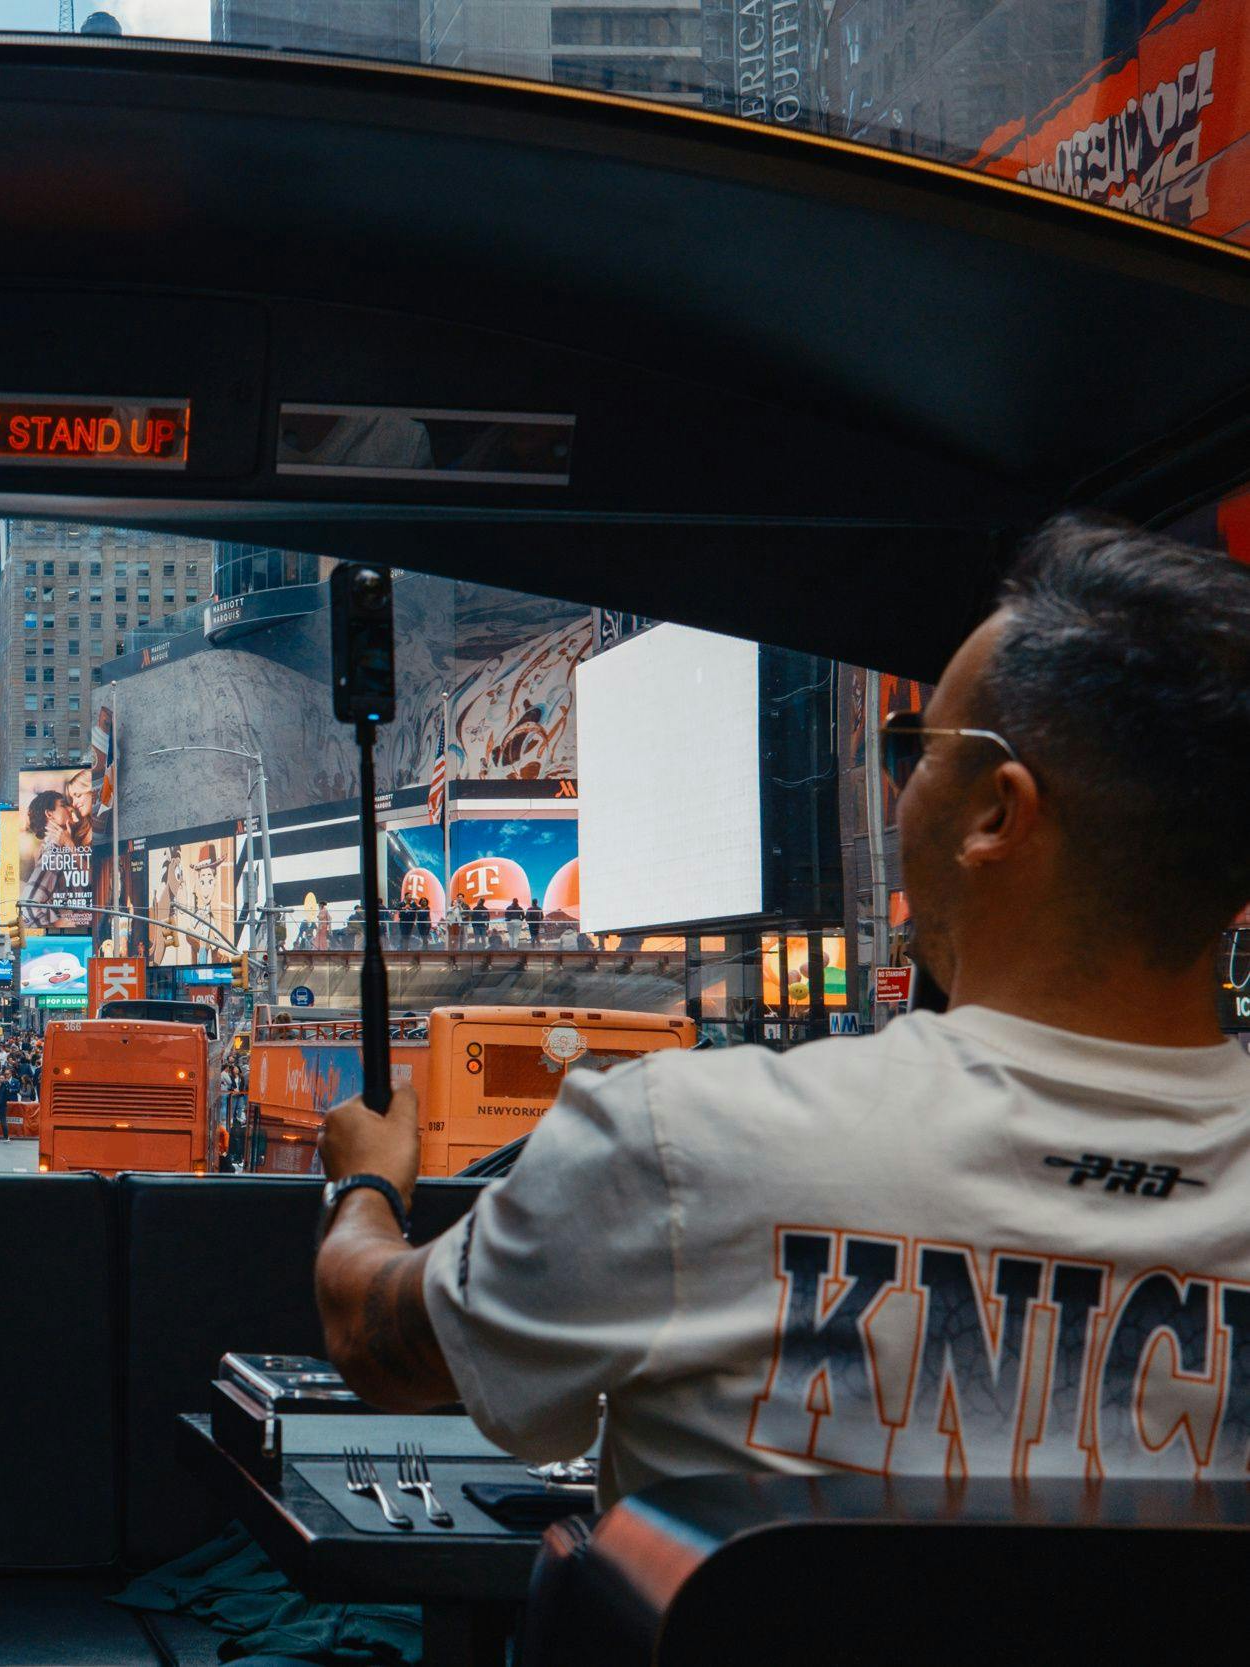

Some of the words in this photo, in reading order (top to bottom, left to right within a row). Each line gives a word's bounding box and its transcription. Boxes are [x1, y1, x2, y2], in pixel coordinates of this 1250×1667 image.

[8, 415, 121, 452] STAND
[129, 418, 175, 453] UP
[213, 598, 244, 613] MARRIOTT
[213, 609, 240, 623] MARQUIS
[151, 641, 170, 653] MARRIOTT
[151, 651, 168, 661] MARQUIS
[41, 853, 92, 871] REGRETT
[63, 870, 90, 888] YOU
[64, 1022, 82, 1031] 366
[428, 1121, 445, 1132] 0187
